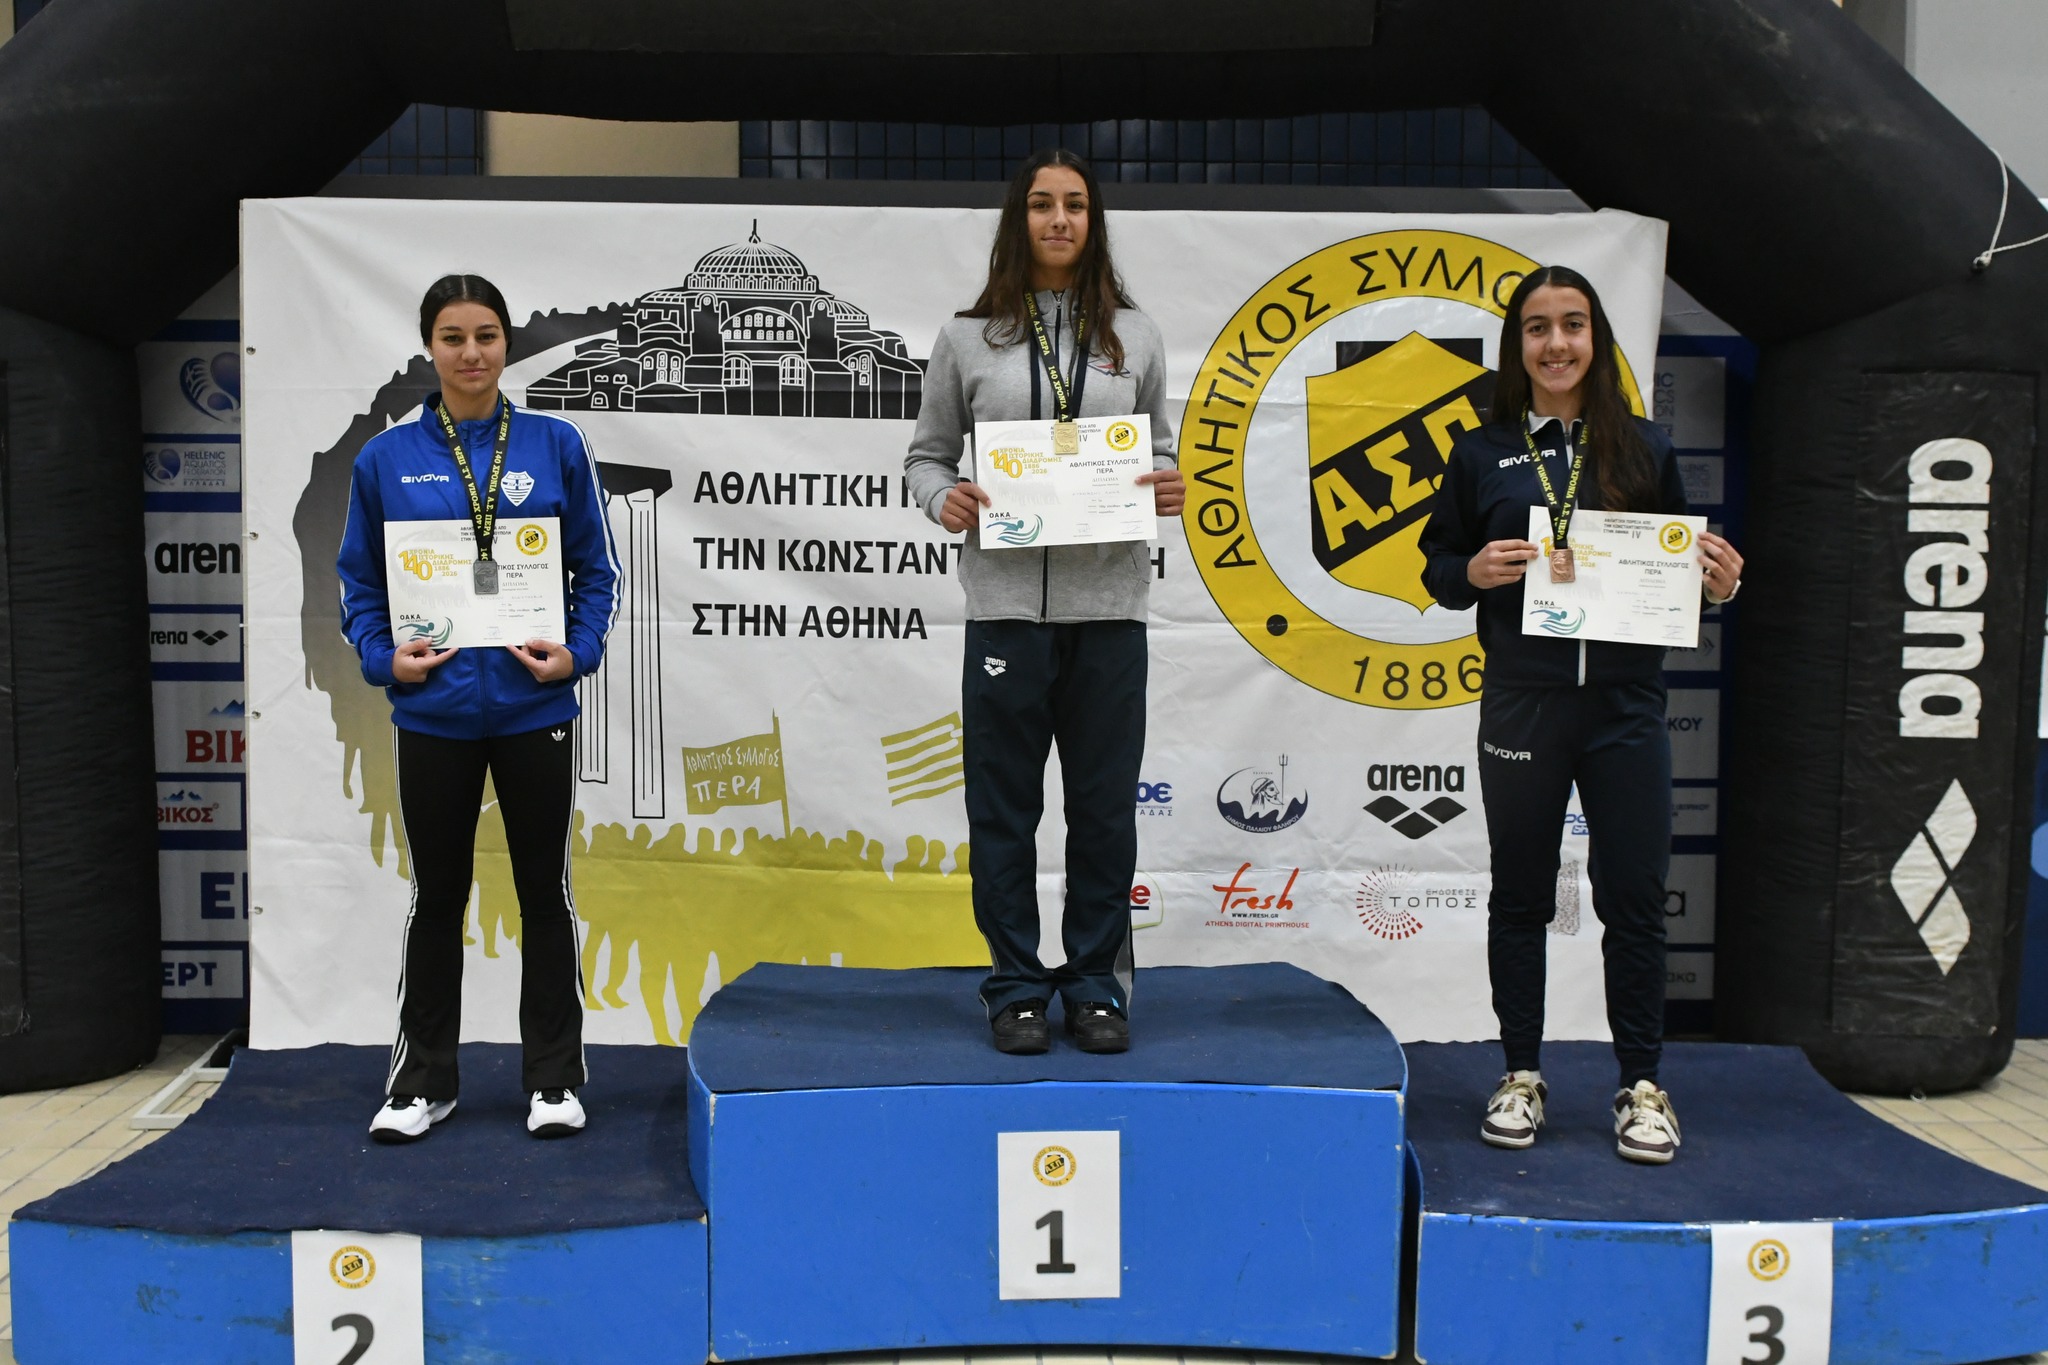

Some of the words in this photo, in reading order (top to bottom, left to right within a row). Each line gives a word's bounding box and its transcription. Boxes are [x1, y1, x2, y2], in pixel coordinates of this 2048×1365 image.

[1048, 365, 1058, 380] 140
[1194, 274, 1331, 569] ΑΘΛΗΤΙΚΟΣ
[184, 450, 226, 460] HELLENIC
[988, 449, 1023, 478] 140
[1069, 460, 1105, 468] ΑΘΛΗΤΙΚΟΣ
[1107, 458, 1140, 466] ΣΥΛΛΟΓΟΣ
[401, 473, 450, 484] GIVOVA
[693, 471, 888, 508] ΑΘΛΗΤΙΚΗ
[1631, 530, 1641, 538] IV
[398, 550, 433, 581] 140
[693, 537, 765, 571] ΤΗΝ
[1618, 559, 1655, 567] ΑΘΛΗΤΙΚΟΣ
[1656, 561, 1689, 569] ΣΥΛΛΟΓΟΣ
[1898, 437, 1993, 740] arena
[692, 603, 787, 637] ΣΤΗΝ
[799, 605, 928, 640] ΑΘΗΝΑ
[985, 656, 1007, 667] arena
[1353, 654, 1485, 701] 1886
[686, 746, 733, 774] ΑΘΛΗΤΙΚΟΣ
[736, 746, 780, 768] ΣΥΛΛΟΓΟΣ
[1484, 741, 1532, 761] GIVOVA
[692, 775, 761, 803] ΠΕΡΑ
[1367, 763, 1465, 793] arena
[1224, 814, 1246, 831] ΔΗΜΟΣ
[1246, 824, 1272, 833] ΠΑΛΑΙΟΥ
[1272, 814, 1300, 831] ΦΑΛΗΡΟΥ
[201, 872, 248, 920] Ε
[1212, 862, 1300, 914] fresh
[1389, 896, 1477, 908] ΤΟΠΟΣ
[161, 961, 218, 987] ΕΡΤ
[1035, 1210, 1076, 1274] 1
[331, 1313, 375, 1365] 2
[1741, 1305, 1786, 1365] 3
